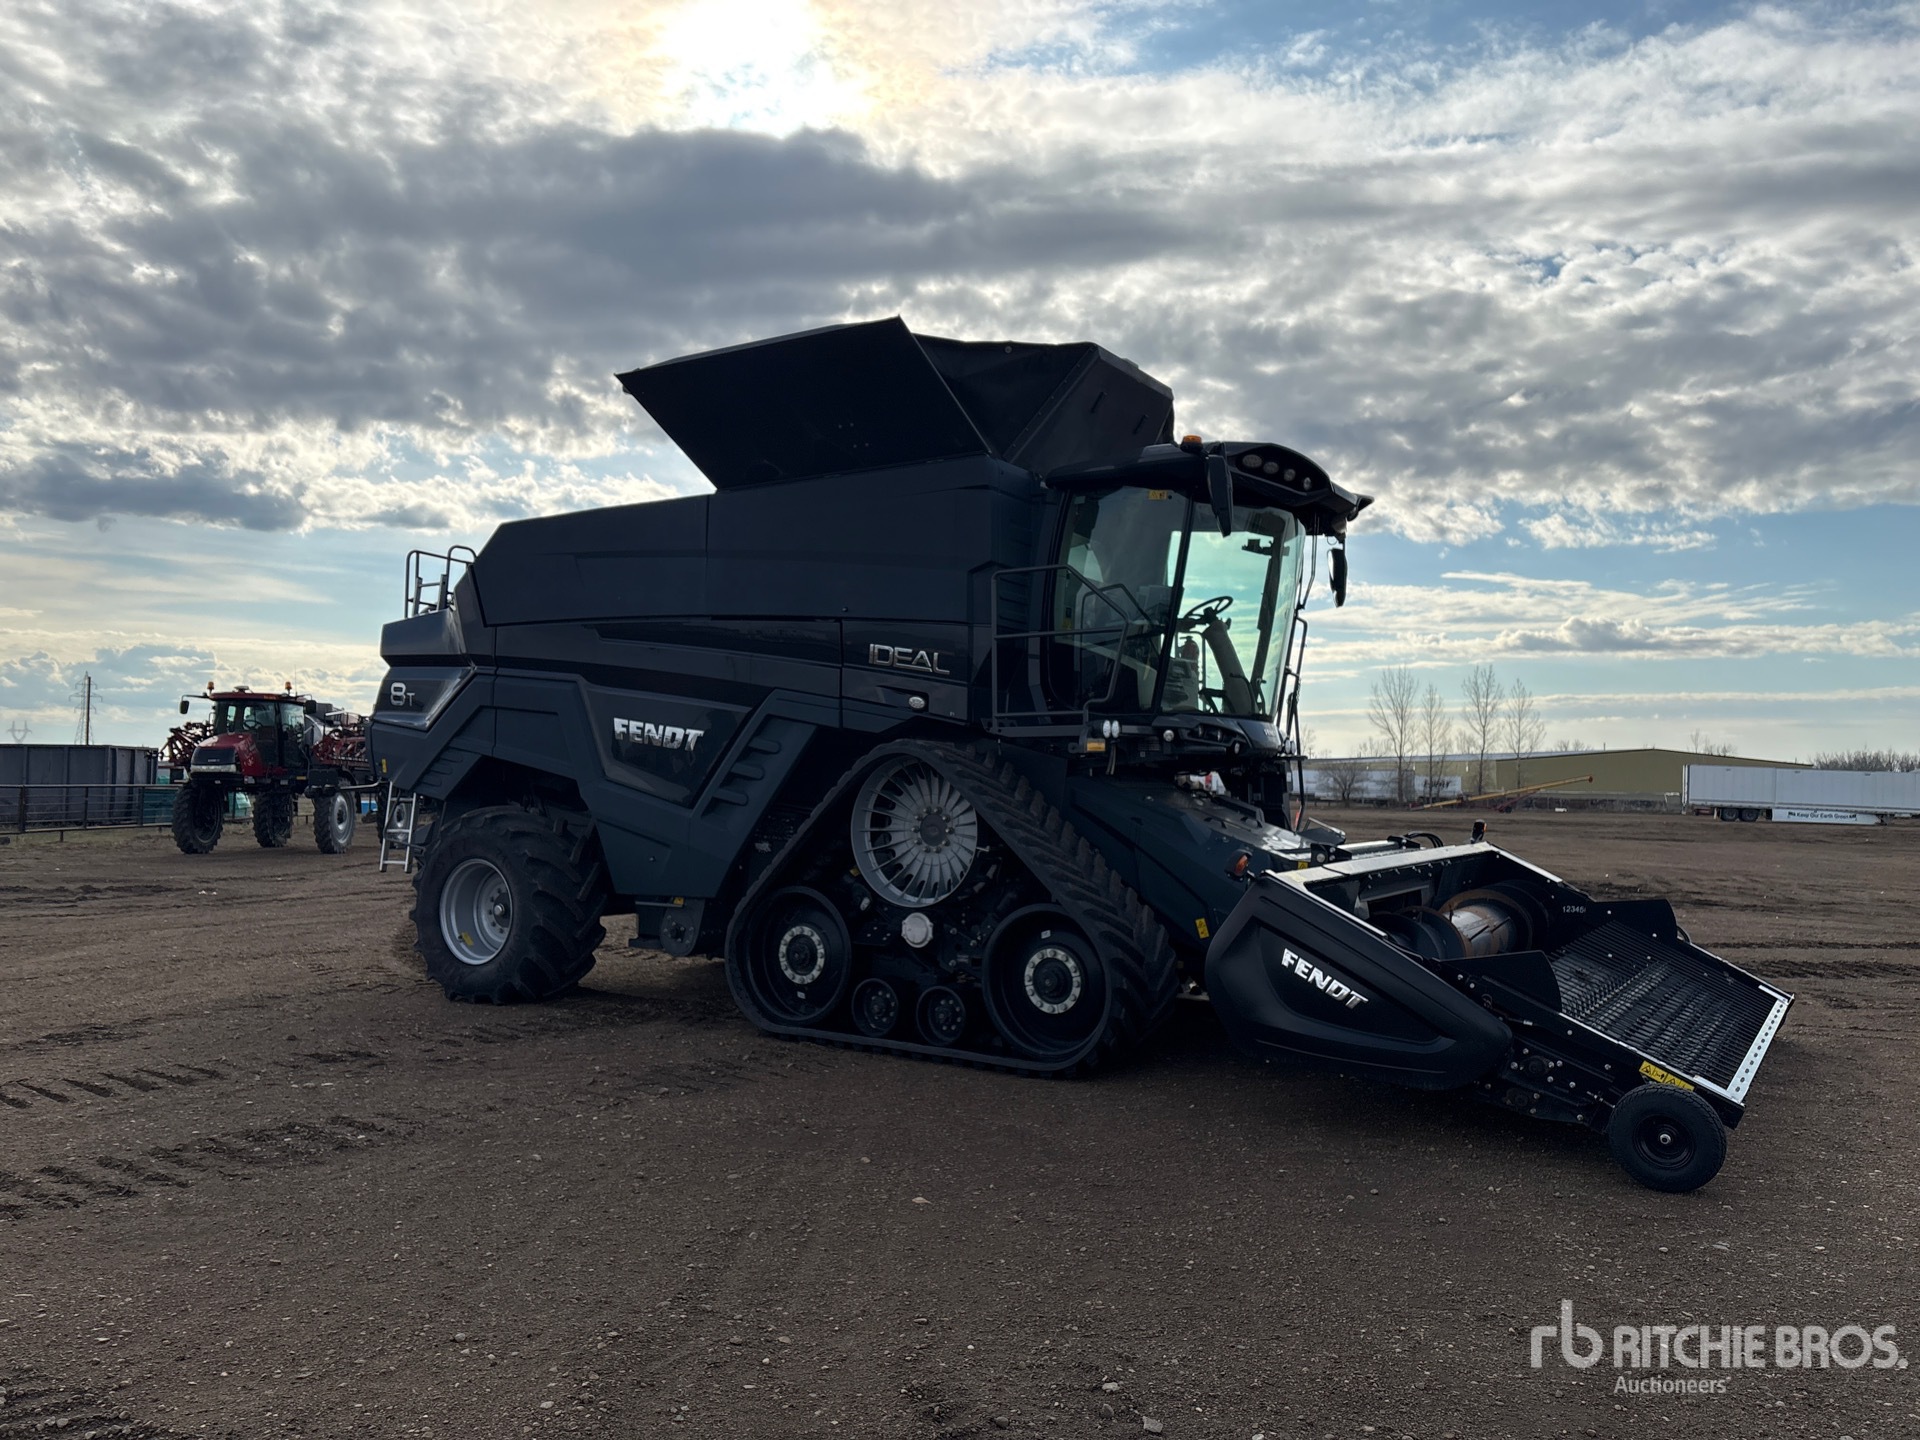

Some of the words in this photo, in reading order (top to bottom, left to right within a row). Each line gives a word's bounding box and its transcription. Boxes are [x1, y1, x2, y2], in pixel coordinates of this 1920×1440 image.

[868, 643, 951, 675] IDEAL
[613, 717, 705, 752] FENDT
[1281, 948, 1369, 1009] FENDT
